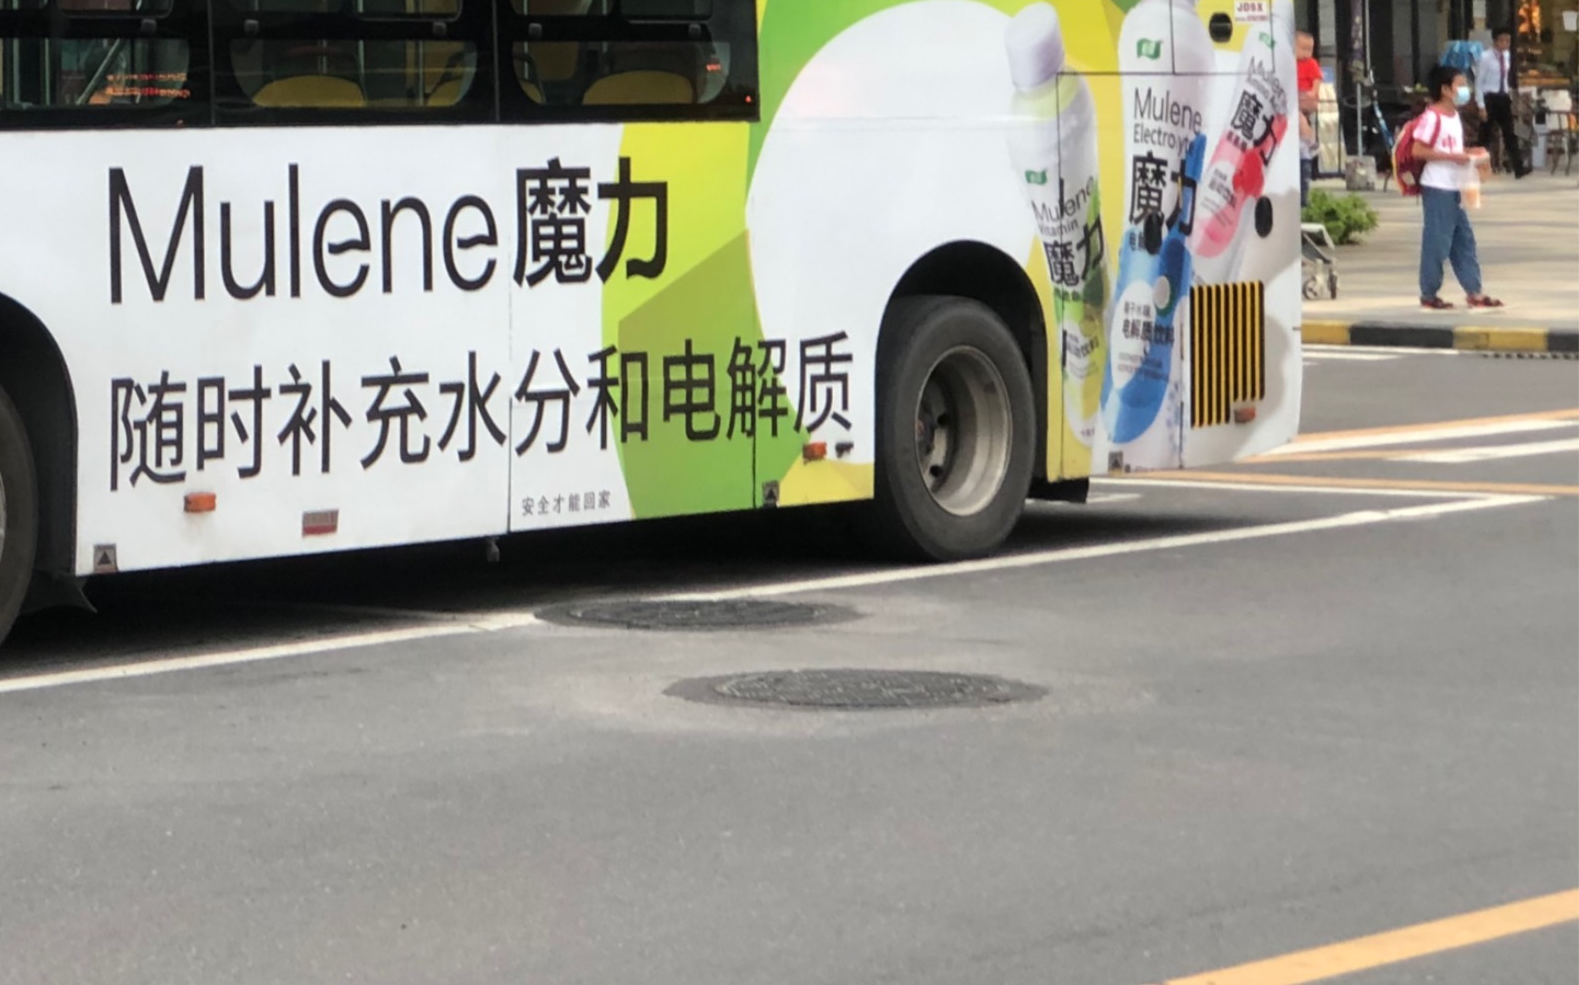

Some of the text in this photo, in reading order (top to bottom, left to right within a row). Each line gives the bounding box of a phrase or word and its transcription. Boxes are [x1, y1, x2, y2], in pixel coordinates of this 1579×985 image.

[1133, 86, 1202, 135] Mulene
[1031, 176, 1095, 222] Muene
[1129, 150, 1198, 236] 魔力
[108, 156, 670, 305] Mulene魔力
[110, 331, 854, 492] 随时补充水分和电解质
[522, 490, 611, 517] 安全才能回家
